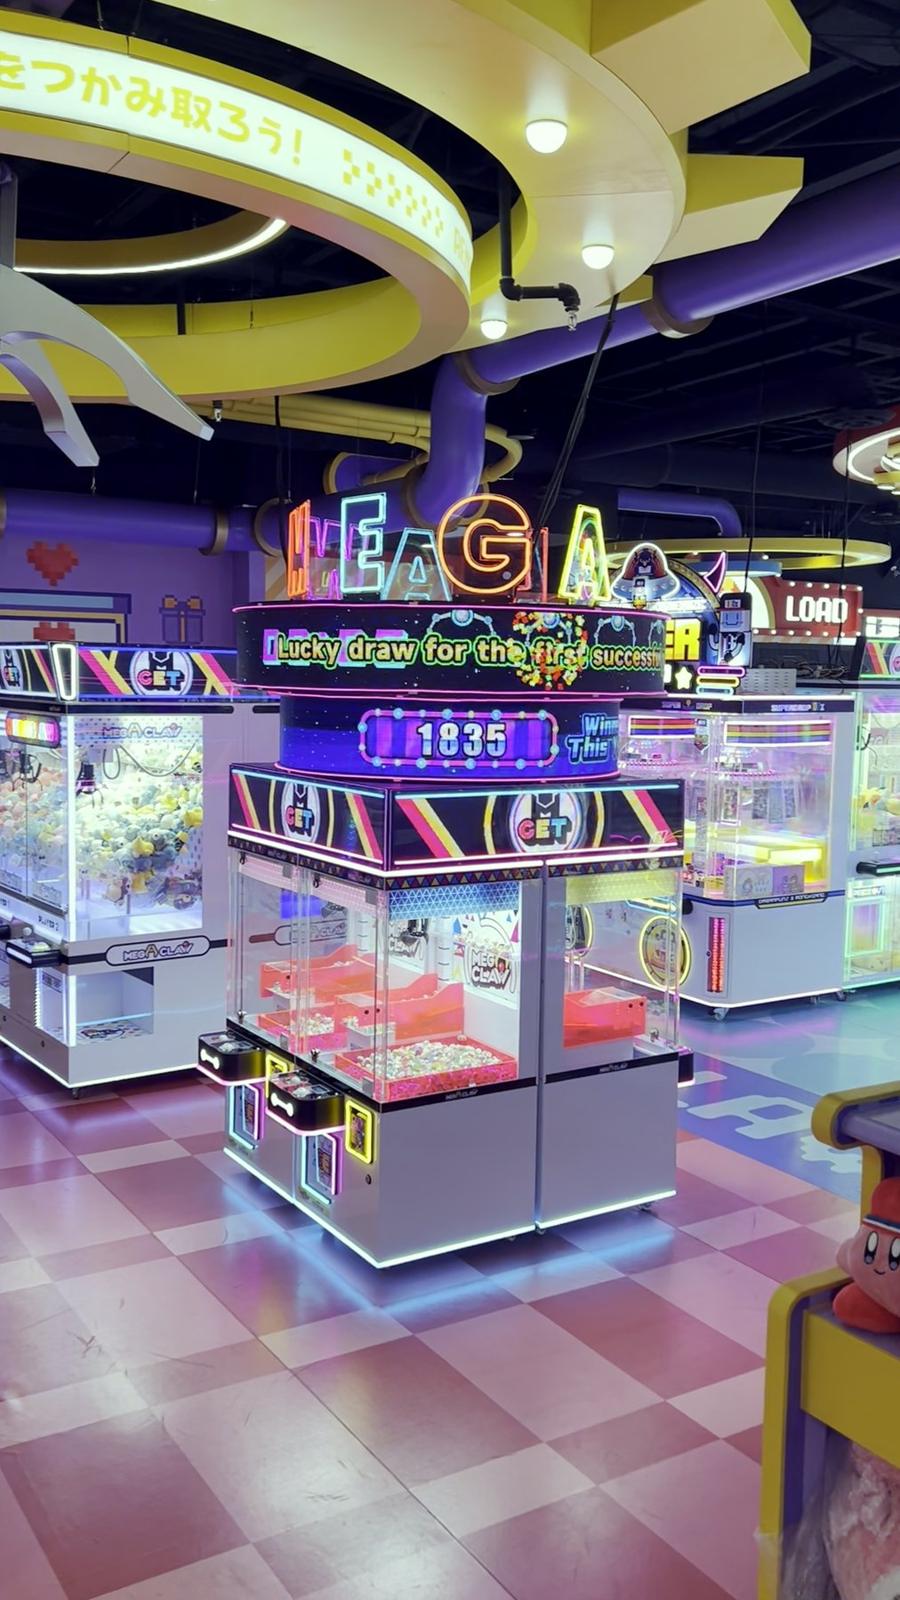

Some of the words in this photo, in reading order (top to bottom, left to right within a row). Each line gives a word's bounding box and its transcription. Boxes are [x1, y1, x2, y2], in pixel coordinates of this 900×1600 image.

[785, 595, 848, 624] LOAD
[277, 636, 341, 667] Lucky
[348, 637, 416, 663] draw
[423, 636, 469, 662] for
[476, 637, 524, 664] the
[532, 639, 588, 666] first
[417, 722, 507, 757] 1835
[568, 736, 609, 759] This
[471, 965, 512, 986] CLAW
